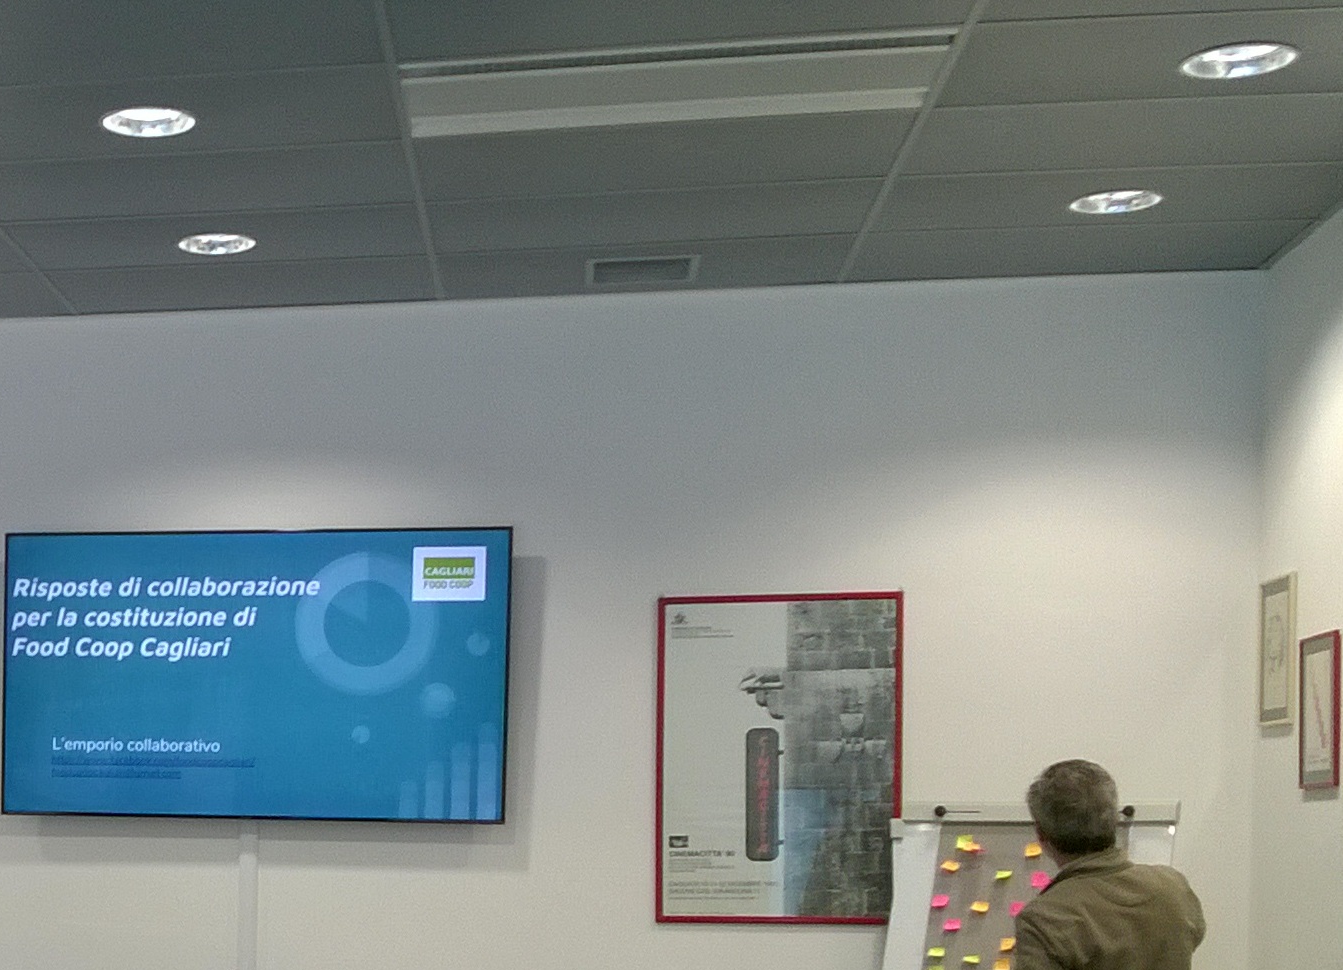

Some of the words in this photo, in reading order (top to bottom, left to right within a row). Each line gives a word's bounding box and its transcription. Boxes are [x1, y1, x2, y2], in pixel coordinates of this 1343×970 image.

[425, 566, 474, 576] CAGLIARI
[13, 577, 112, 602] Risposte
[118, 576, 143, 597] di
[147, 576, 321, 597] collaborazione
[423, 580, 448, 590] FOOD
[449, 580, 474, 590] COOP
[11, 610, 53, 632] per
[56, 607, 78, 627] la
[84, 606, 227, 628] costituzione
[233, 606, 258, 627] di
[12, 636, 70, 657] Food
[75, 636, 134, 662] Coop
[140, 636, 232, 663] Cagliari
[52, 736, 124, 753] L'emporio
[126, 738, 221, 753] collaborativo
